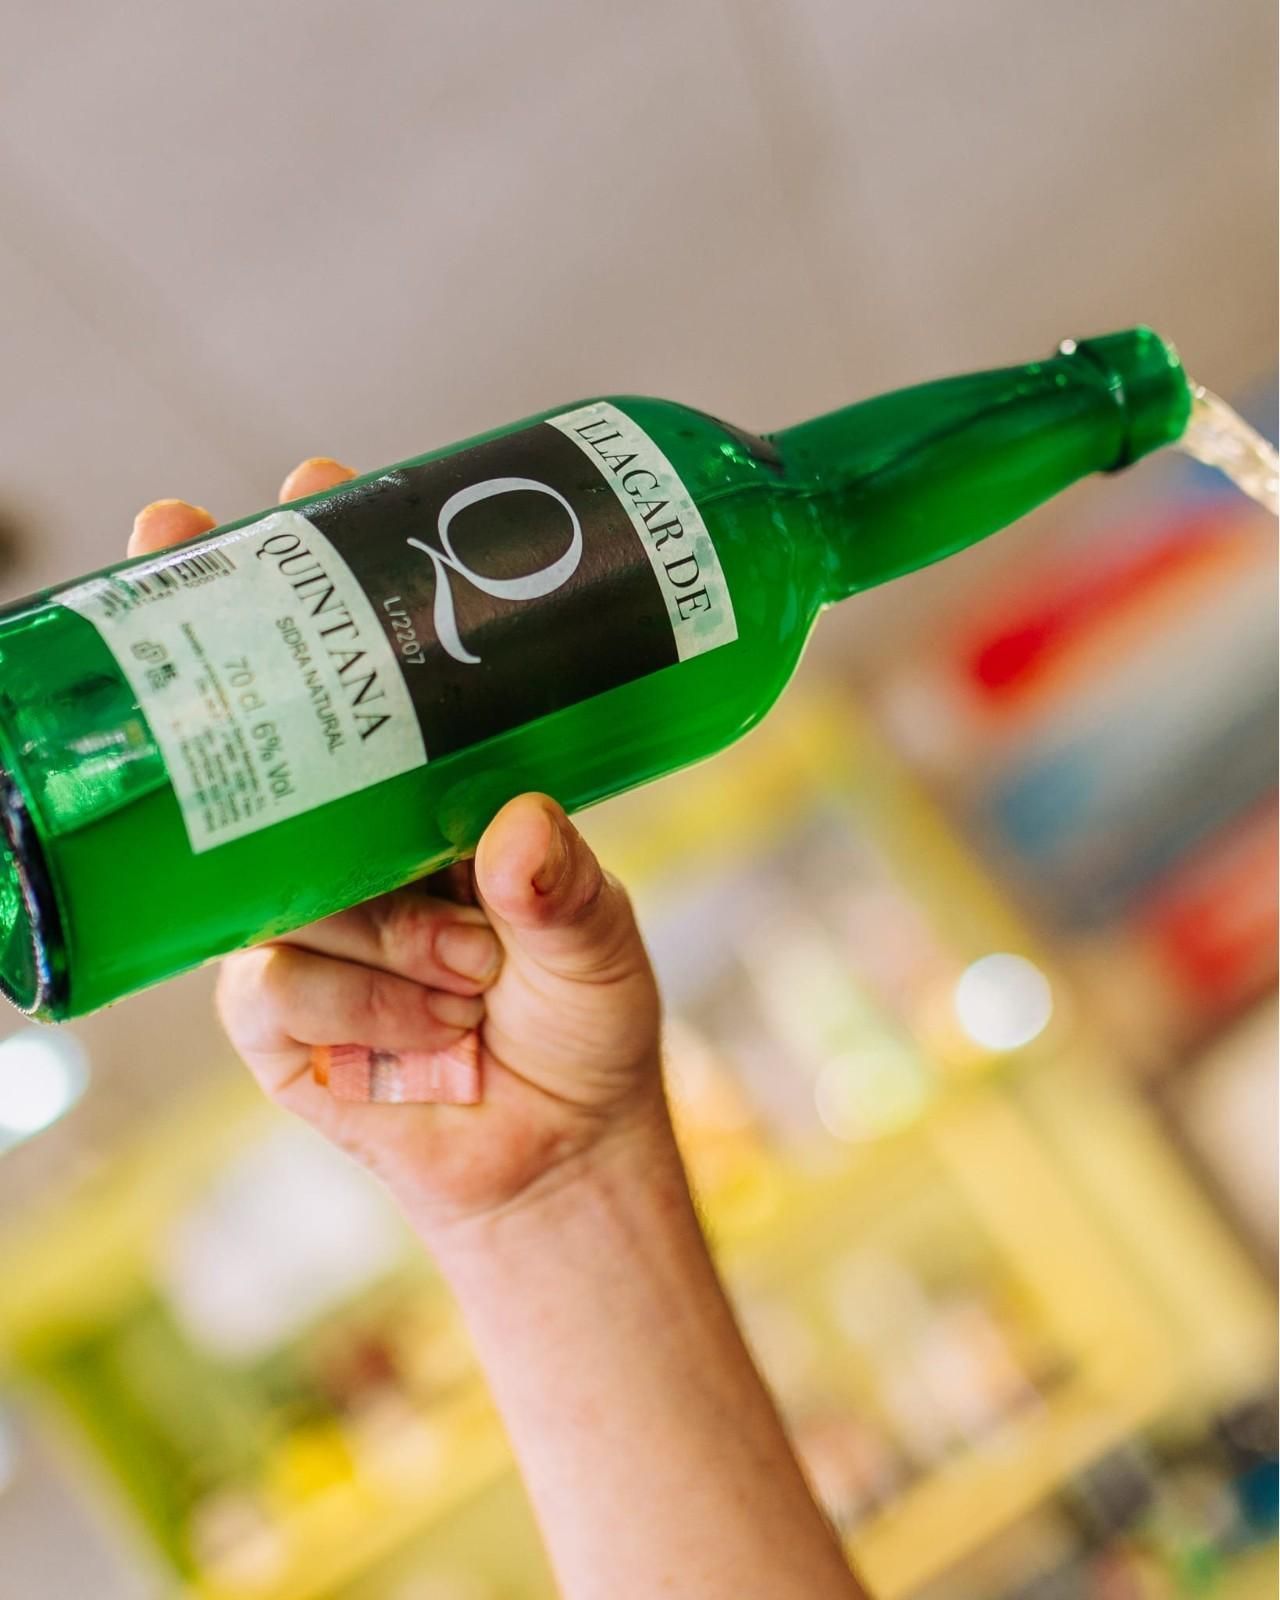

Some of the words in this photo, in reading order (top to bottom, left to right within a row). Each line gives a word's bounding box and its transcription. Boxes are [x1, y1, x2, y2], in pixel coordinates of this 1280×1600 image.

[406, 476, 583, 664] Q
[574, 418, 685, 552] LLAGAR
[663, 551, 712, 622] DE
[224, 656, 256, 687] 70
[252, 720, 283, 762] 6%
[256, 533, 392, 743] QUINTANA
[276, 616, 312, 669] SIDRA
[304, 670, 346, 755] NATURAL
